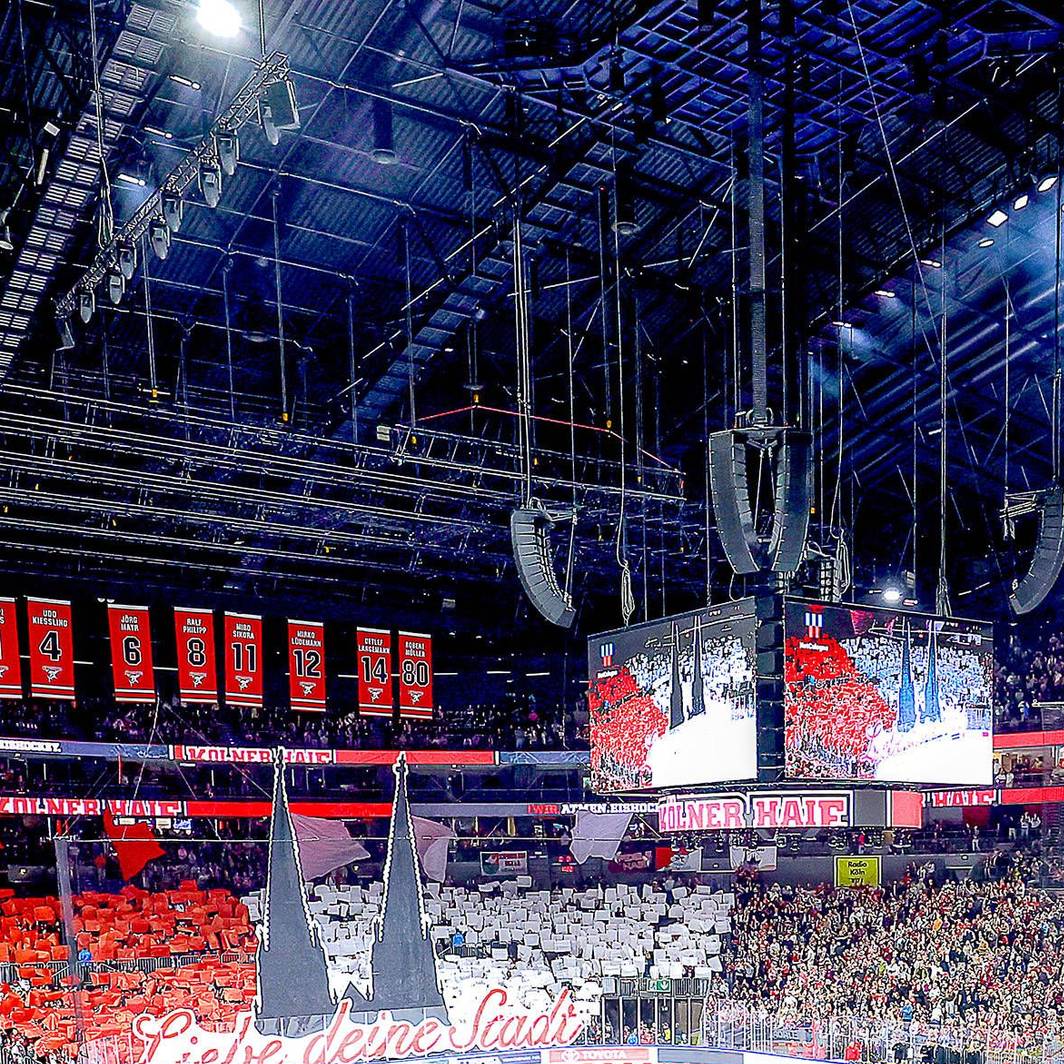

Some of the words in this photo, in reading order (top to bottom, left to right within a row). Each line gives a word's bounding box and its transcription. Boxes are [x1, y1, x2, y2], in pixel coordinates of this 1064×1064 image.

[32, 616, 68, 628] KIESSLING
[43, 610, 57, 619] UDO
[120, 615, 138, 624] JÖRG
[183, 625, 207, 634] PHILIPP
[232, 630, 255, 639] SIKORA
[39, 630, 62, 661] 4
[122, 636, 142, 666] 6
[187, 638, 207, 667] 8
[231, 642, 257, 673] 11
[293, 649, 321, 678] 12
[361, 656, 388, 684] 14
[402, 659, 430, 687] 80
[449, 988, 584, 1049] Stadt
[582, 1051, 626, 1060] TOYOTA
